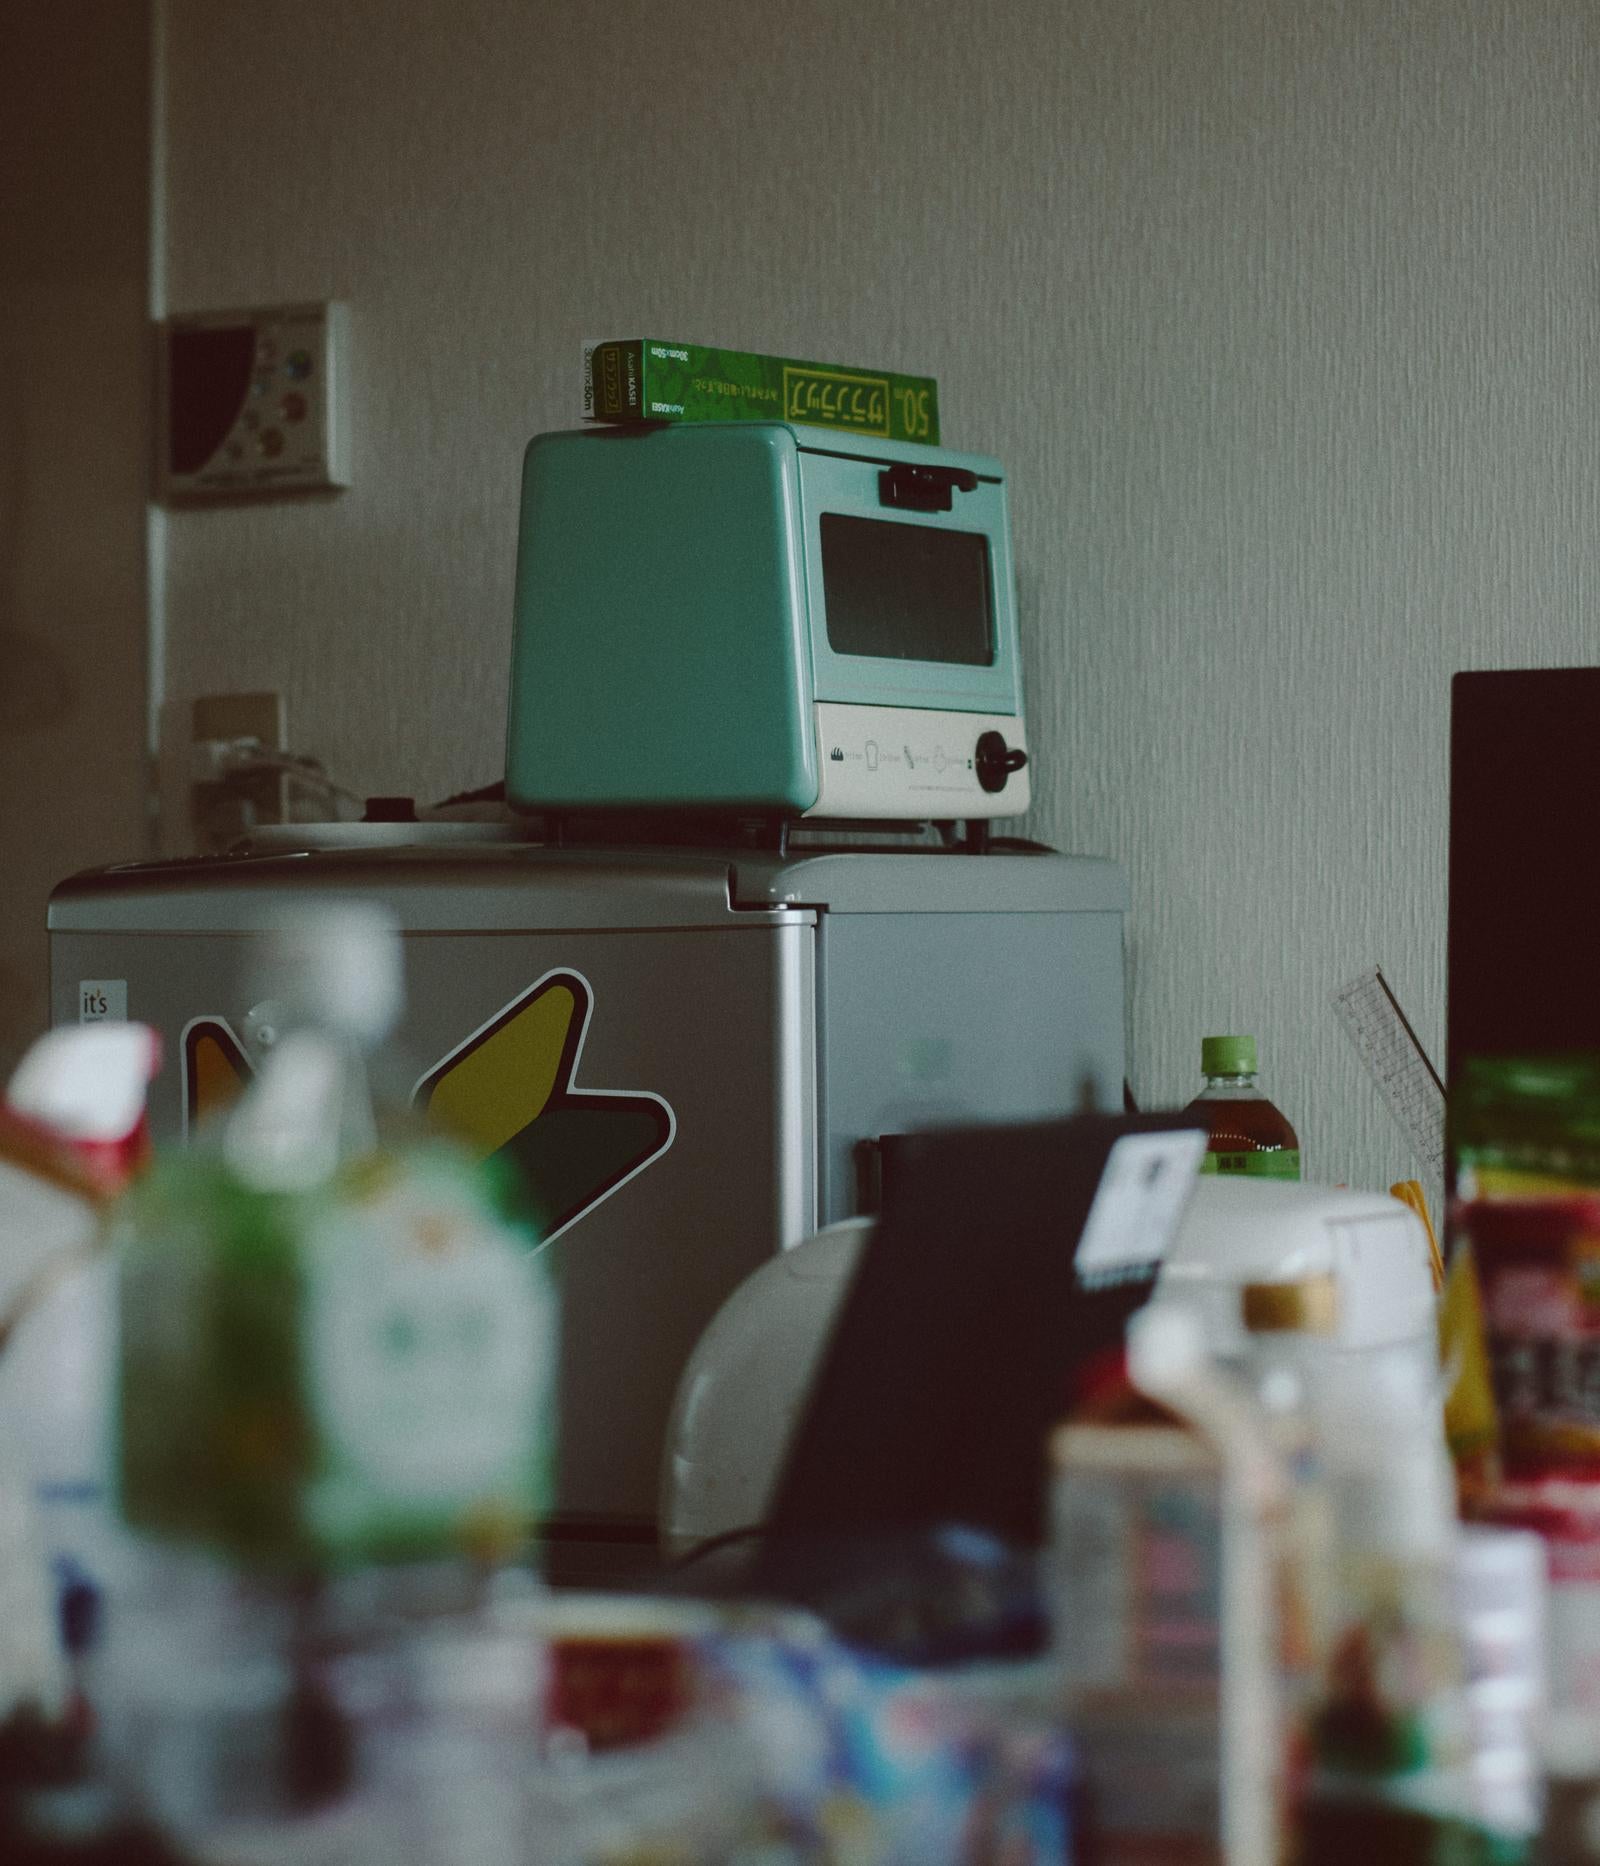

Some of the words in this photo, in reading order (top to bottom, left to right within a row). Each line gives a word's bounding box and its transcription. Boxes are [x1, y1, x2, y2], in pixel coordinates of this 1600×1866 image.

[790, 381, 883, 424] サランラップ
[84, 989, 107, 1013] it's
